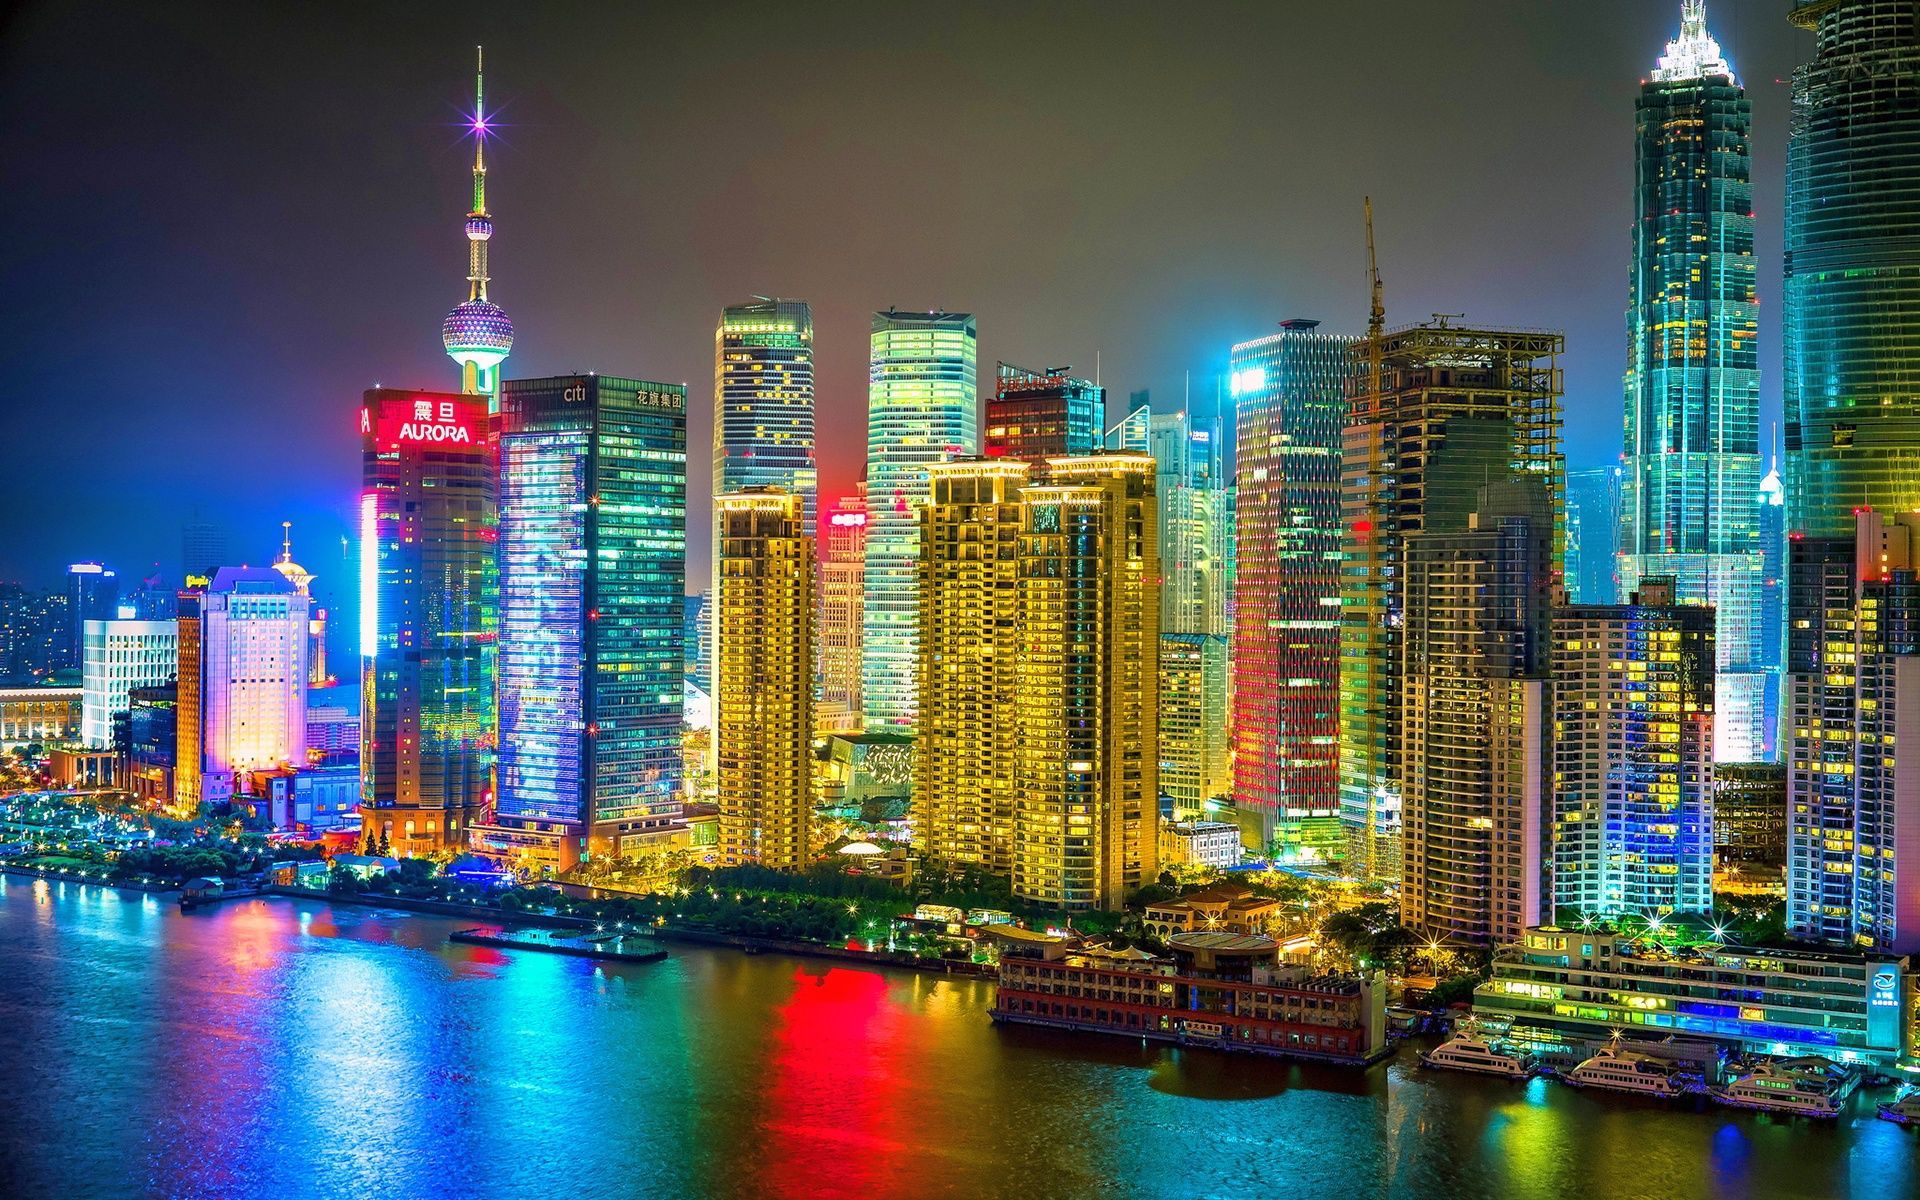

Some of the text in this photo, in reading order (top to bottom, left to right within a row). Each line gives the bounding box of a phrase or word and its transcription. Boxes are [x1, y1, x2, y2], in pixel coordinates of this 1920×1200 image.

[563, 384, 586, 402] citi
[637, 389, 682, 409] 花旗集团
[413, 400, 456, 423] 震旦
[399, 422, 470, 443] AURORA
